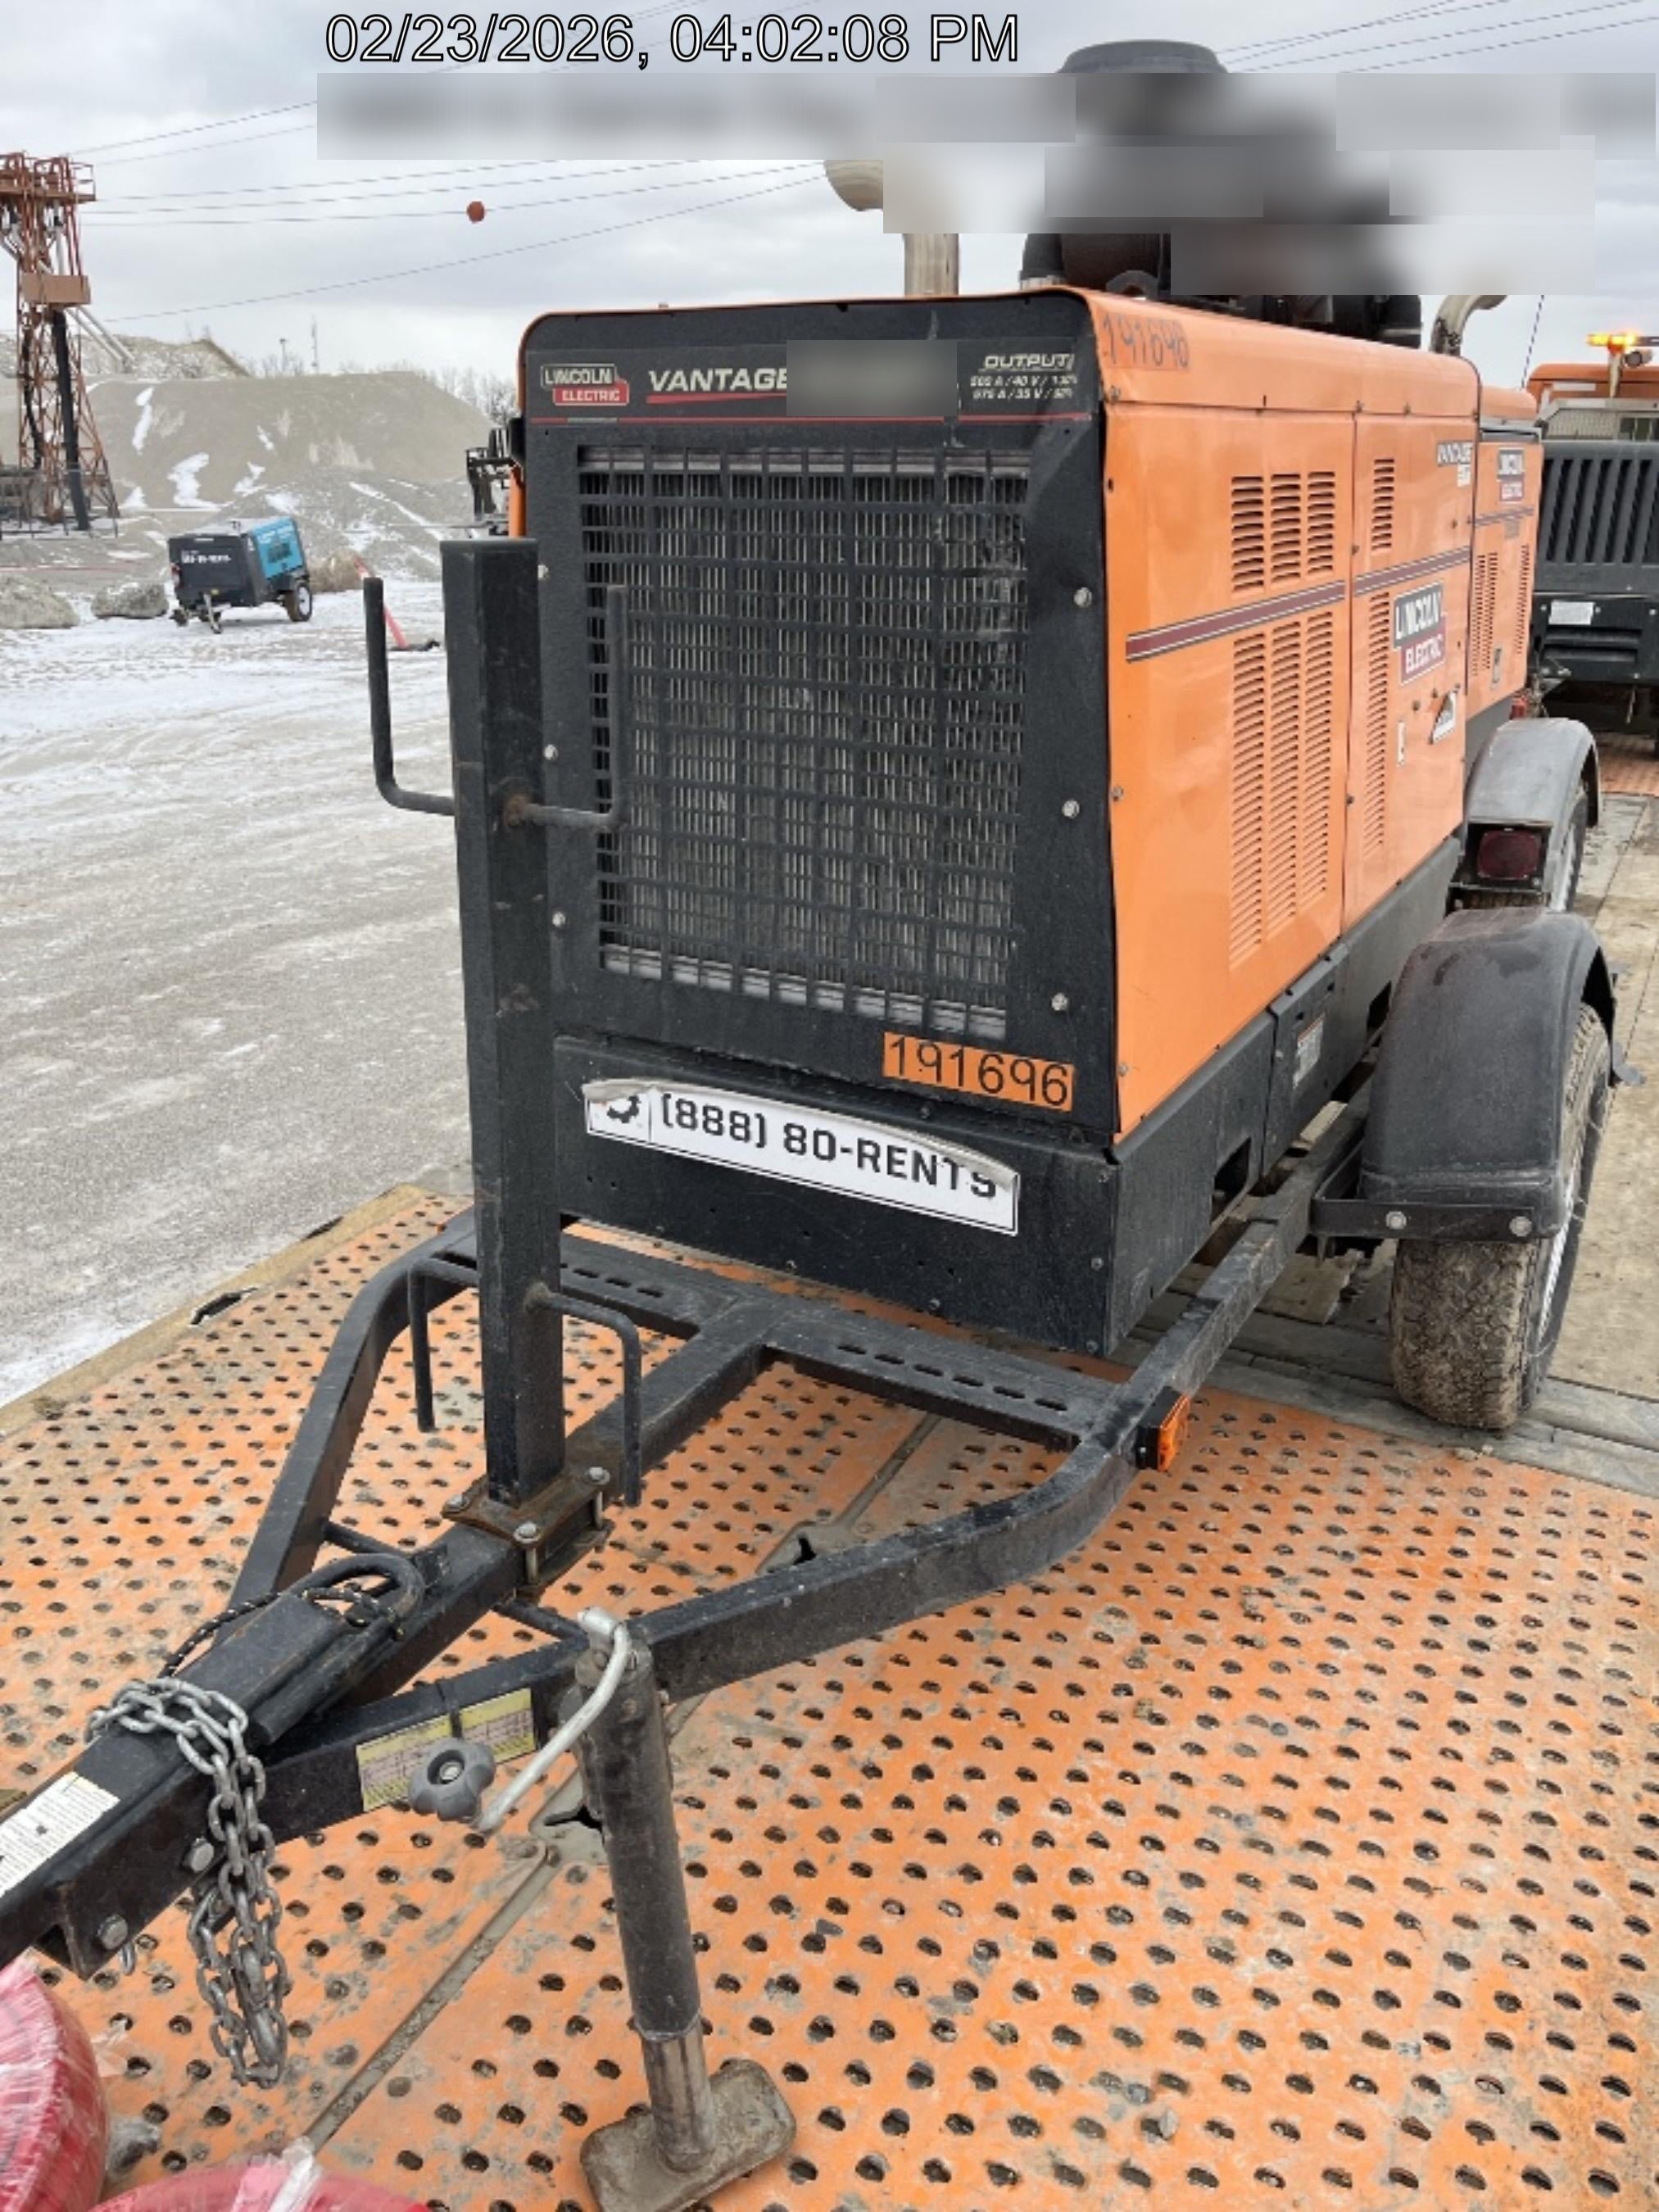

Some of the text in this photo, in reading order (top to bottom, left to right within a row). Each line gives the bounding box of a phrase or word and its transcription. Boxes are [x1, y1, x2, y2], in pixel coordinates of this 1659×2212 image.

[984, 353, 1070, 368] OUTPUT
[544, 369, 613, 384] LINCOLN
[562, 390, 621, 401] ELECTRIC
[890, 1037, 1068, 1106] 191696
[783, 1122, 996, 1198] 80-RENTS
